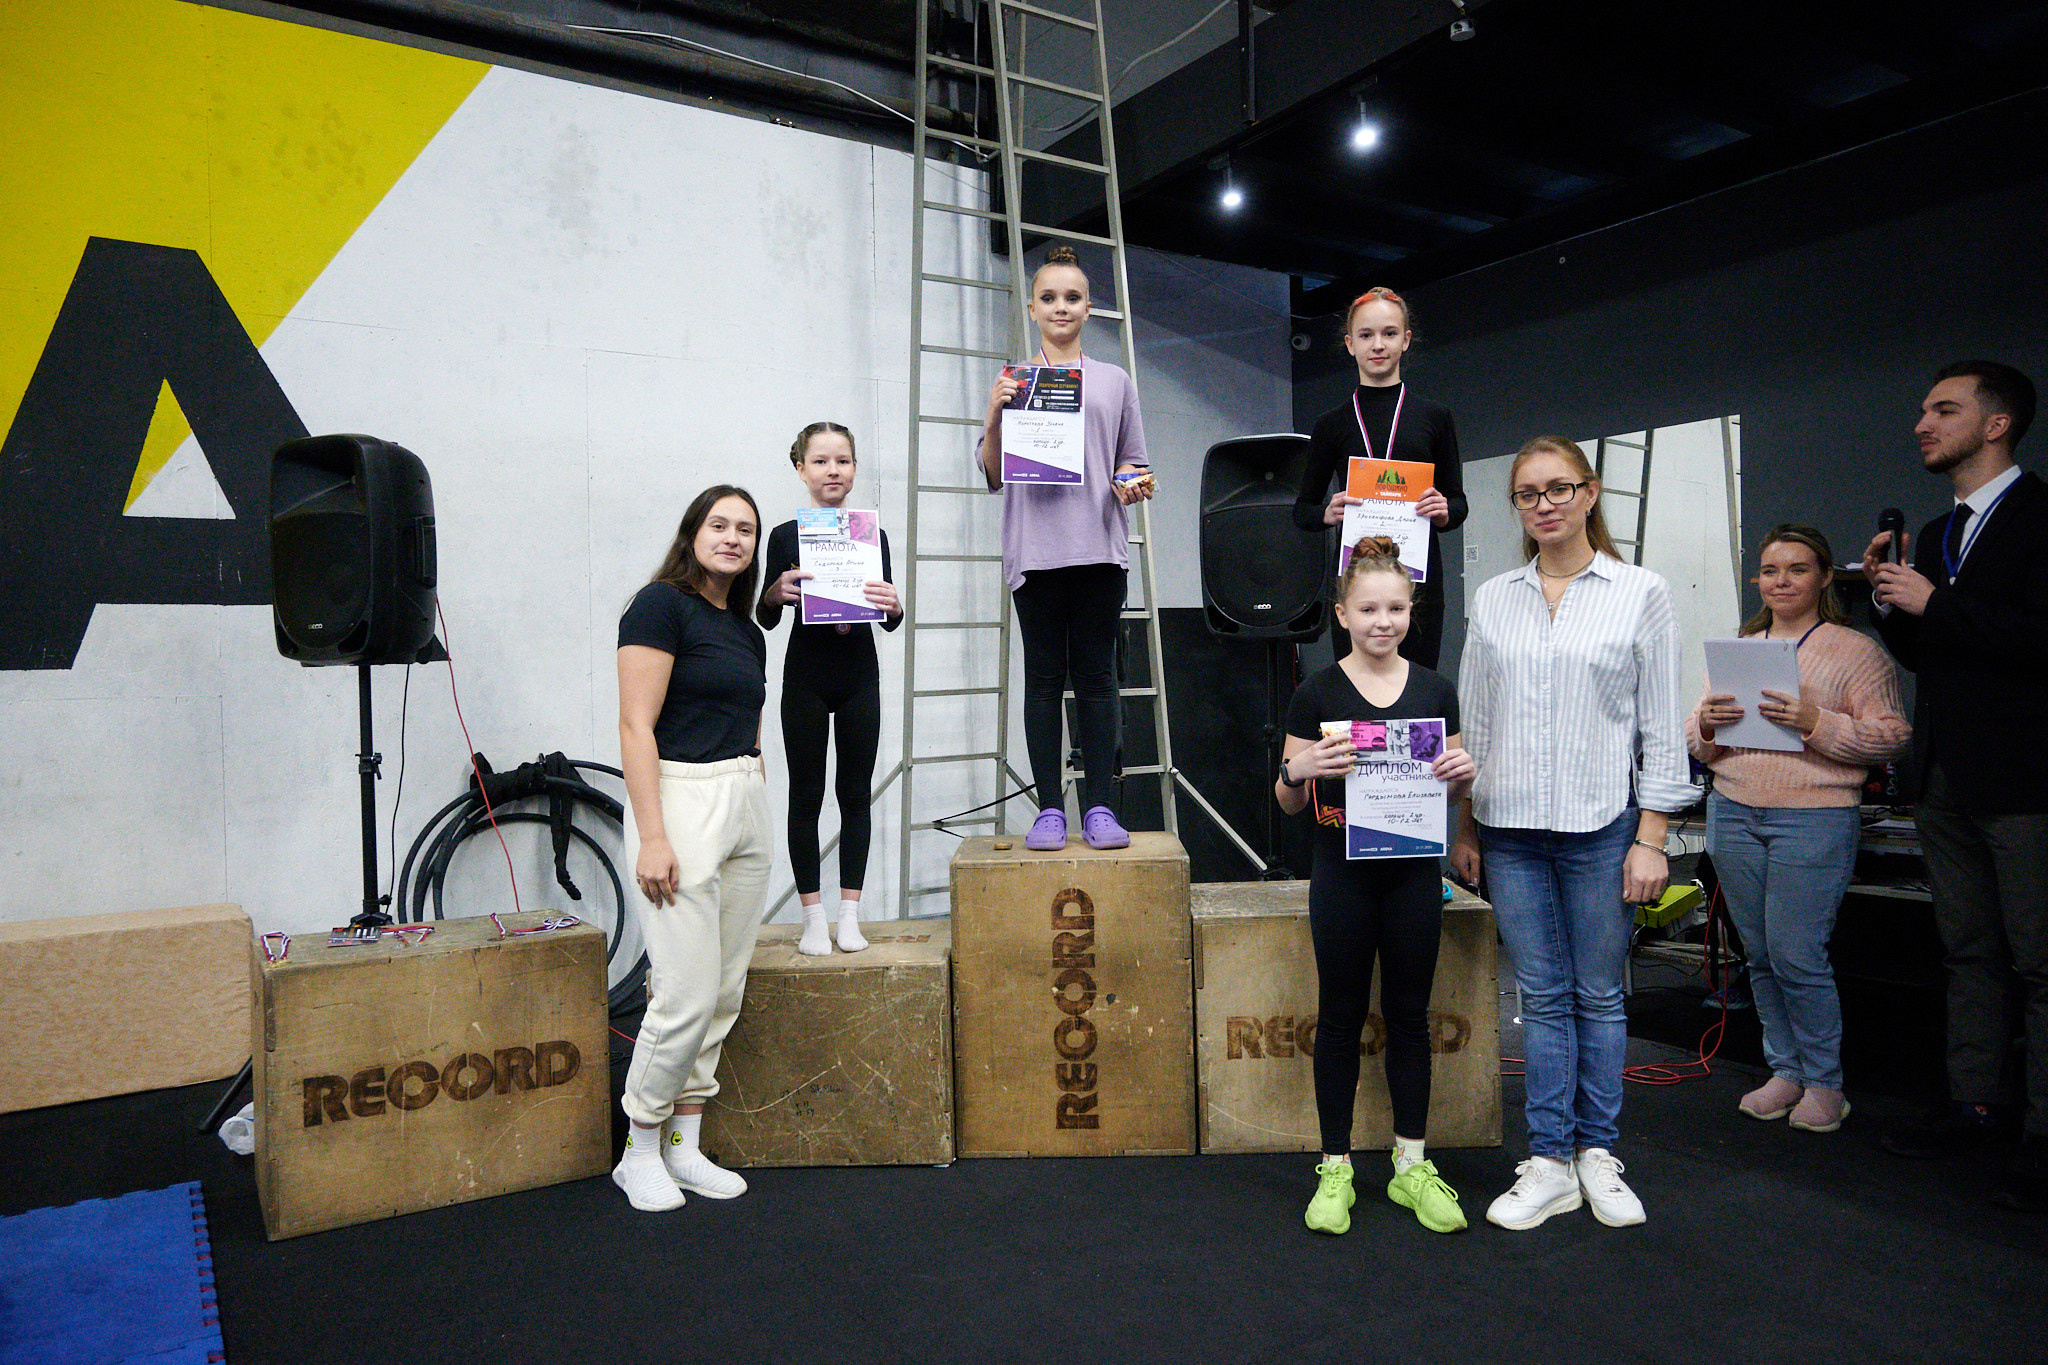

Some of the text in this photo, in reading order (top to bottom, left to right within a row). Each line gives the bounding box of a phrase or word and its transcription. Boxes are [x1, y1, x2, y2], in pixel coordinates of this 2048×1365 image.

[809, 542, 858, 552] ГРАМОТА
[1357, 762, 1422, 778] ДИПЛОМ
[1381, 773, 1434, 784] участника
[1051, 887, 1100, 1130] RECORD
[1226, 1012, 1472, 1060] RECOD
[302, 1040, 581, 1128] RECORD
